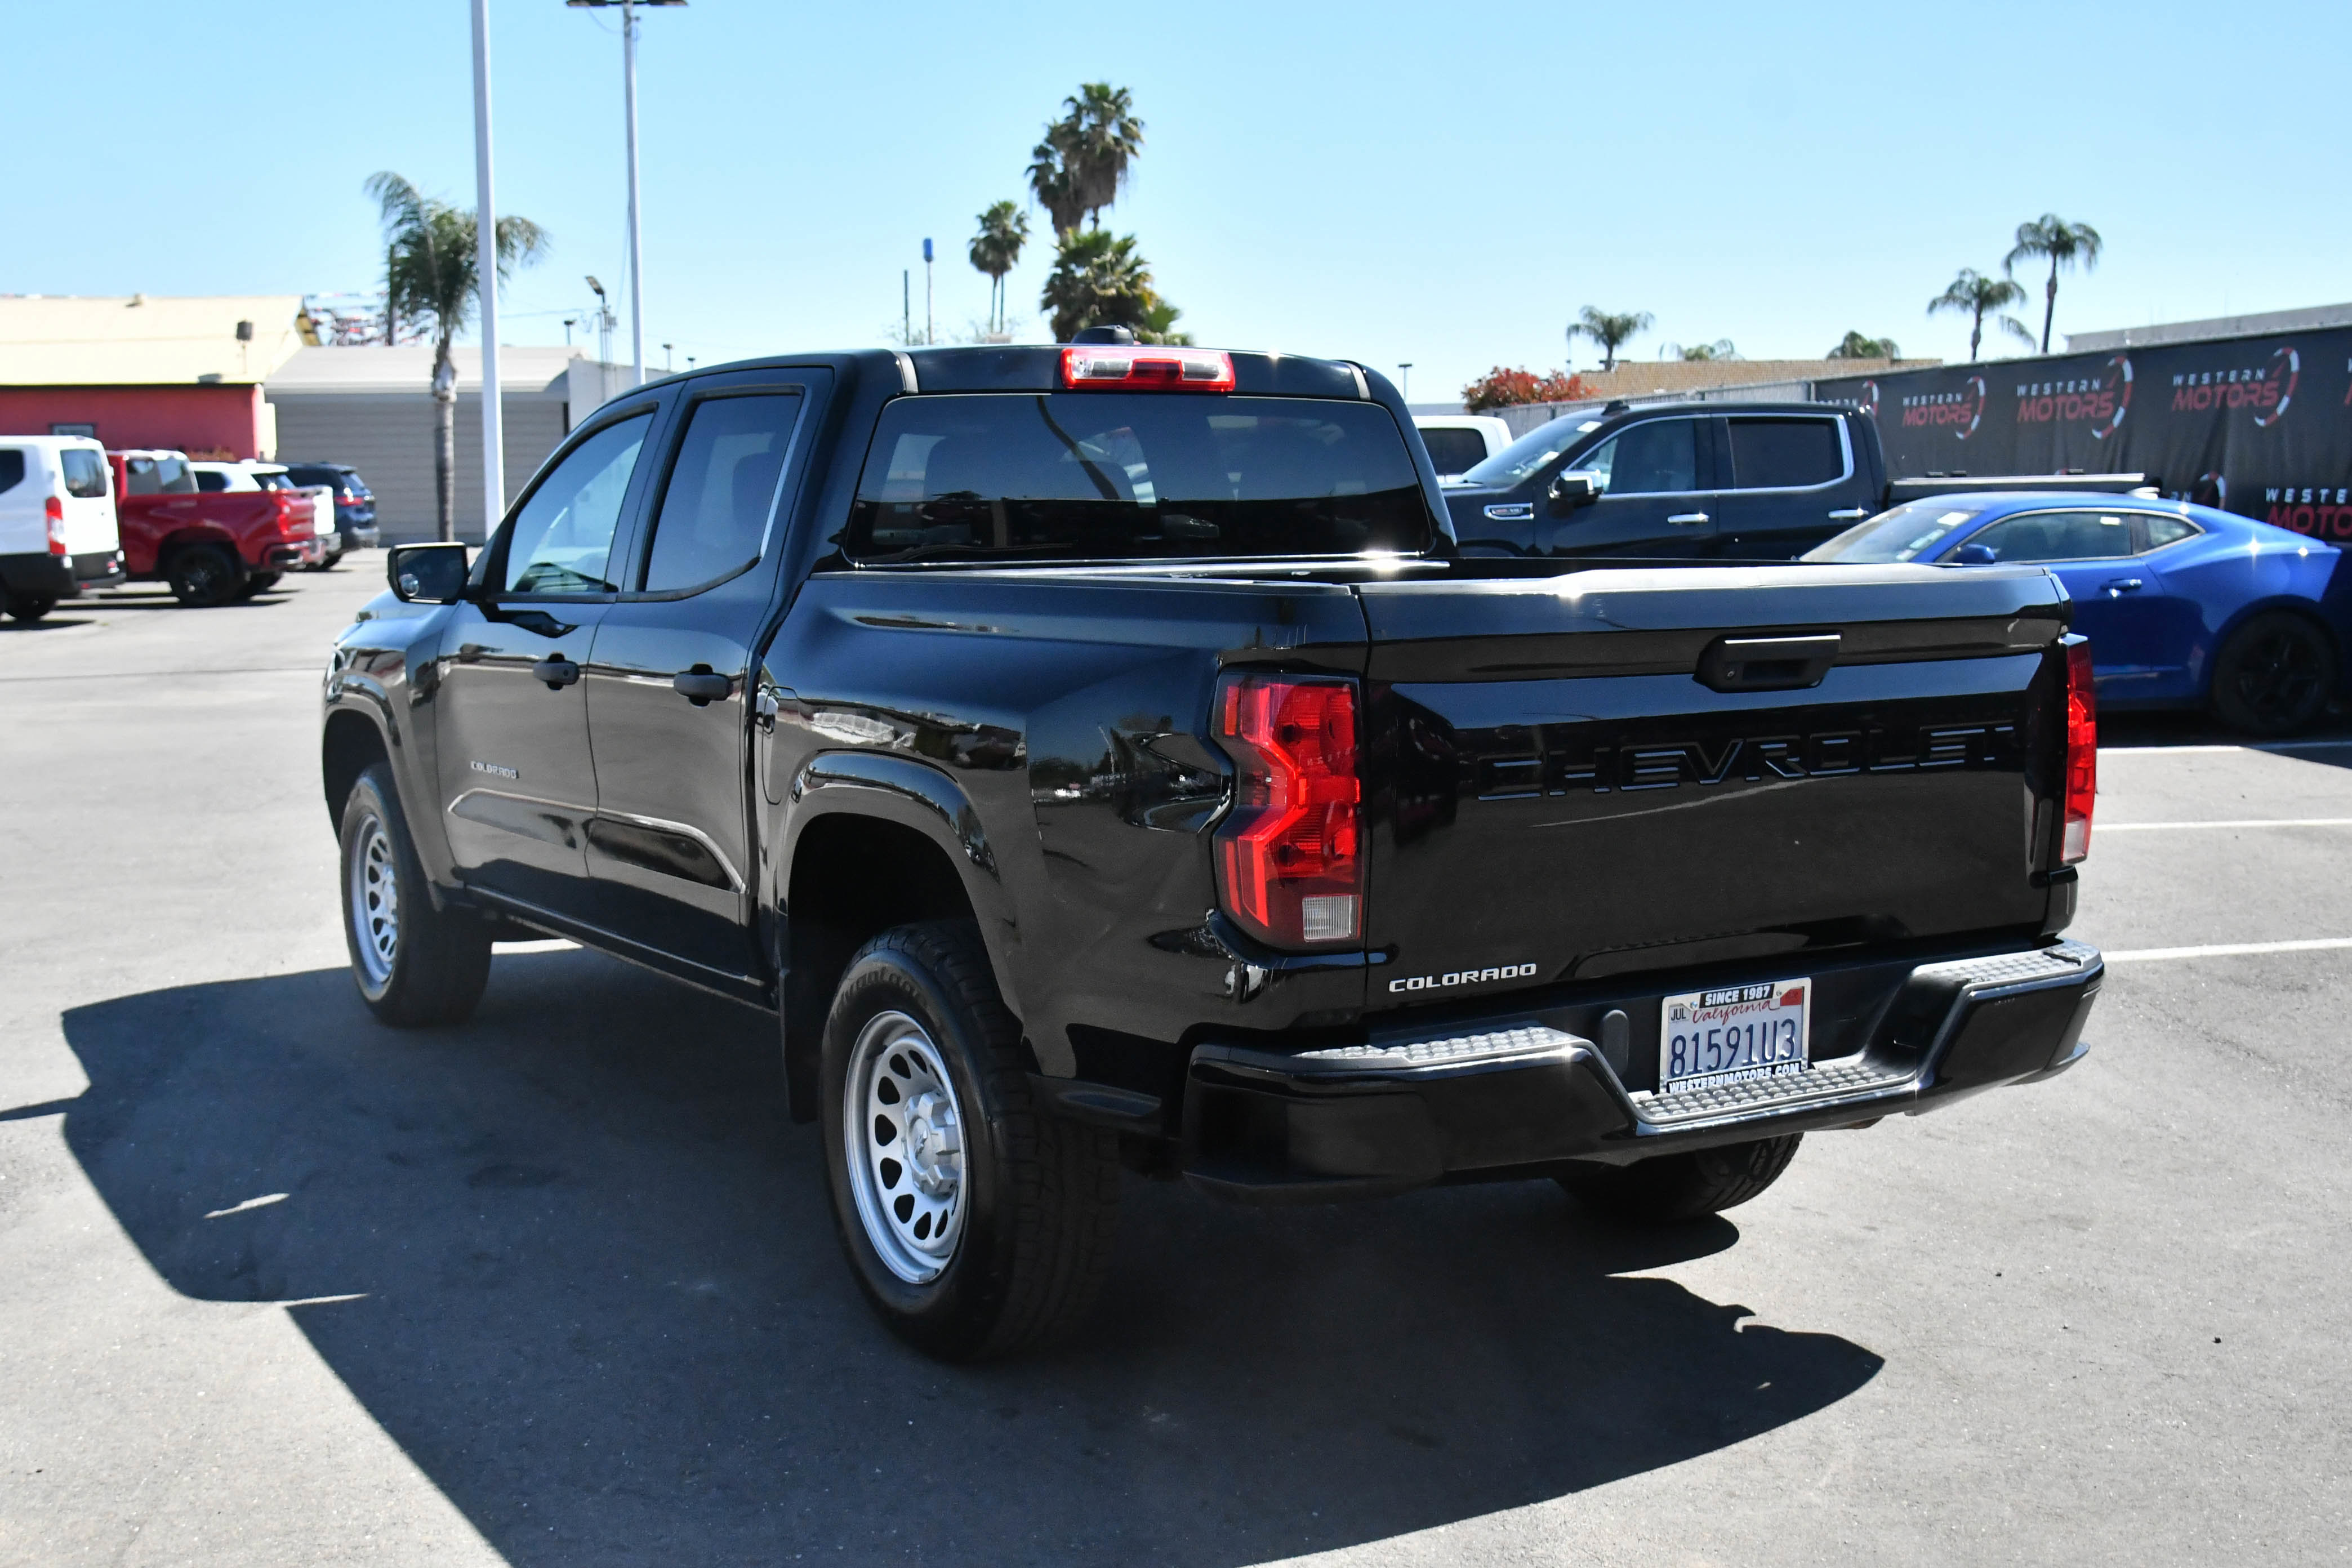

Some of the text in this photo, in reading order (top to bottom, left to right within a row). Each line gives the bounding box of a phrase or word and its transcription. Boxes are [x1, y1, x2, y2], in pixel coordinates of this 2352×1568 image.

[2017, 377, 2101, 397] WESTERN
[2173, 368, 2265, 386] WESTERN
[1903, 393, 1963, 406] WESTERN
[2017, 392, 2115, 423] MOTORS
[2172, 381, 2279, 411] MOTORS
[1903, 402, 1972, 426] MOTORS
[470, 761, 517, 779] COLORADO
[1389, 963, 1536, 992] COLORADO
[1704, 990, 1739, 1006] SINCE
[1743, 986, 1771, 1001] 1987
[1671, 1008, 1686, 1021] JUL
[1692, 999, 1780, 1026] California
[1669, 1018, 1796, 1079] 81591U3
[1669, 1062, 1800, 1094] WESTERNMOTORS.COM
